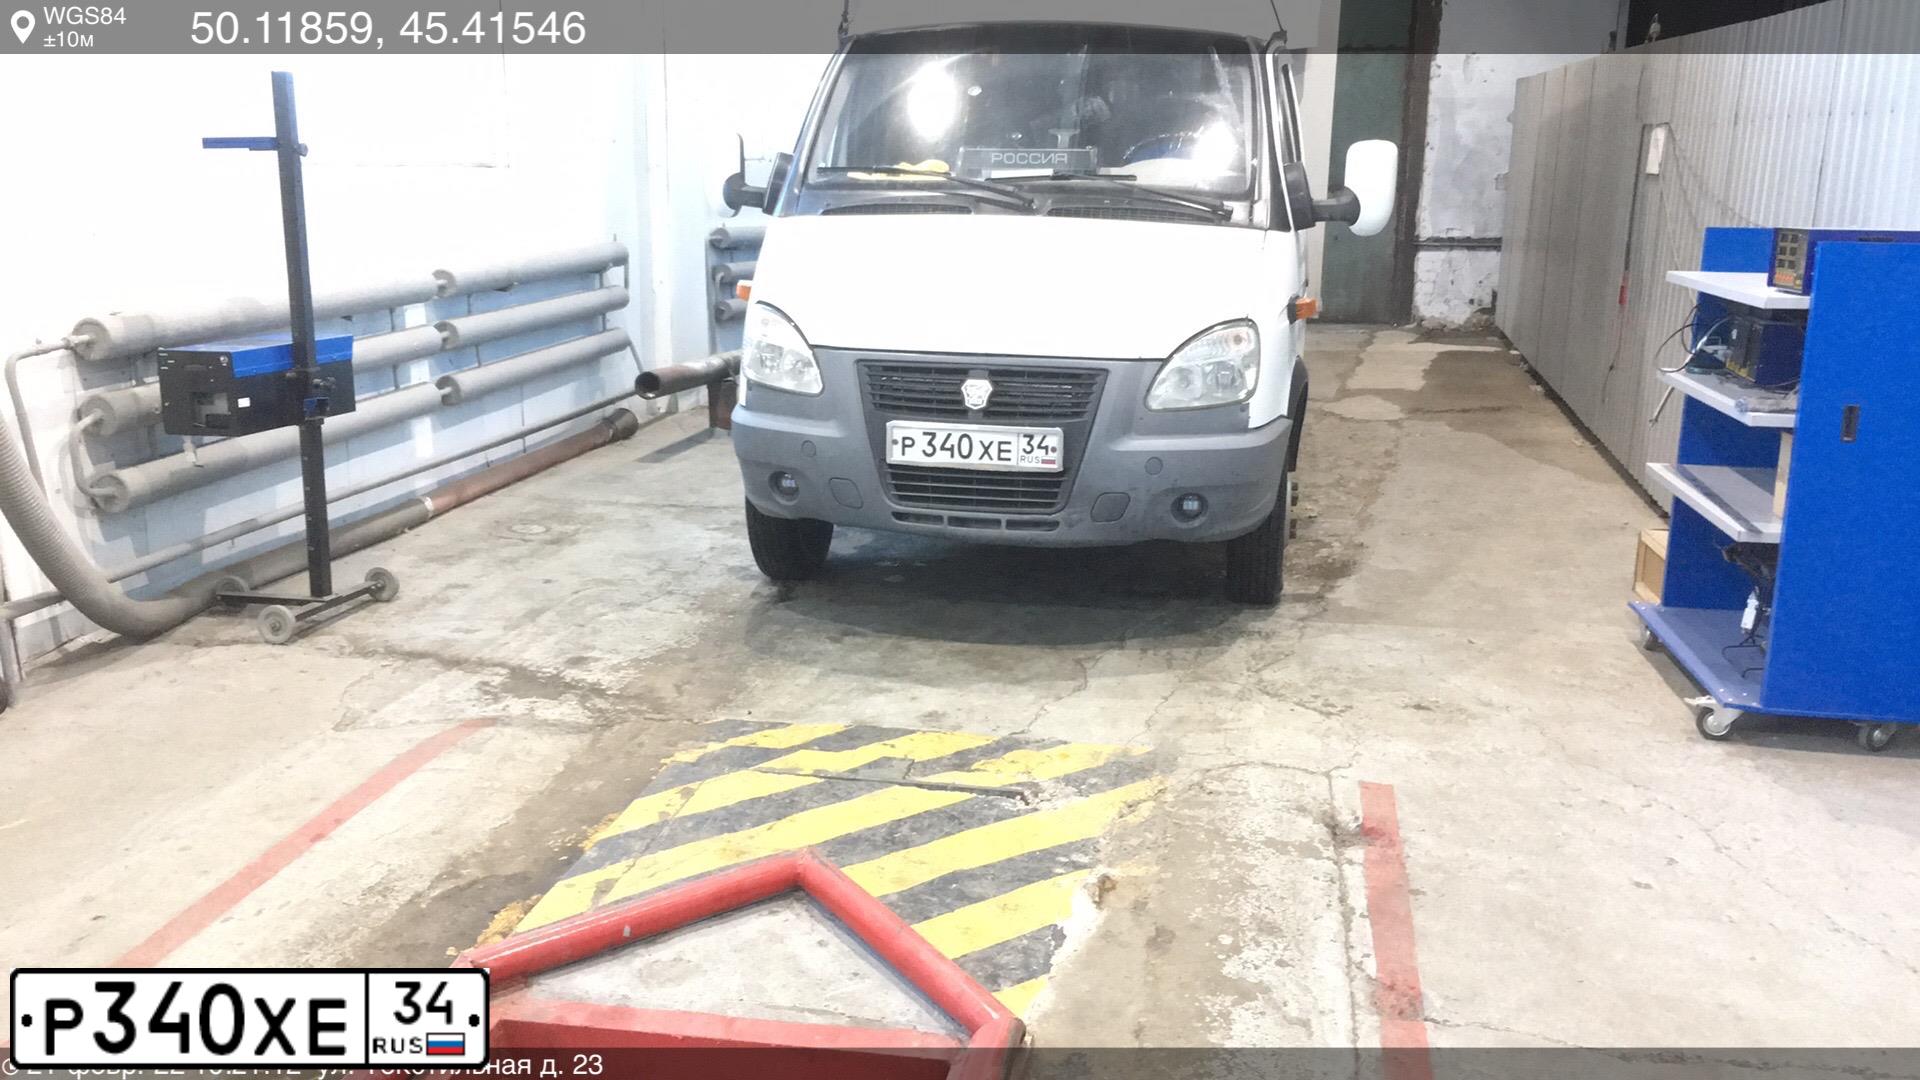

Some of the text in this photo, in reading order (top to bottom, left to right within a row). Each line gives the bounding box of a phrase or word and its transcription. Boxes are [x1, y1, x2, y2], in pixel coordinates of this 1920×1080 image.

[991, 152, 1068, 165] РОССИЯ
[1022, 434, 1050, 456] 34
[1020, 456, 1040, 464] RUS
